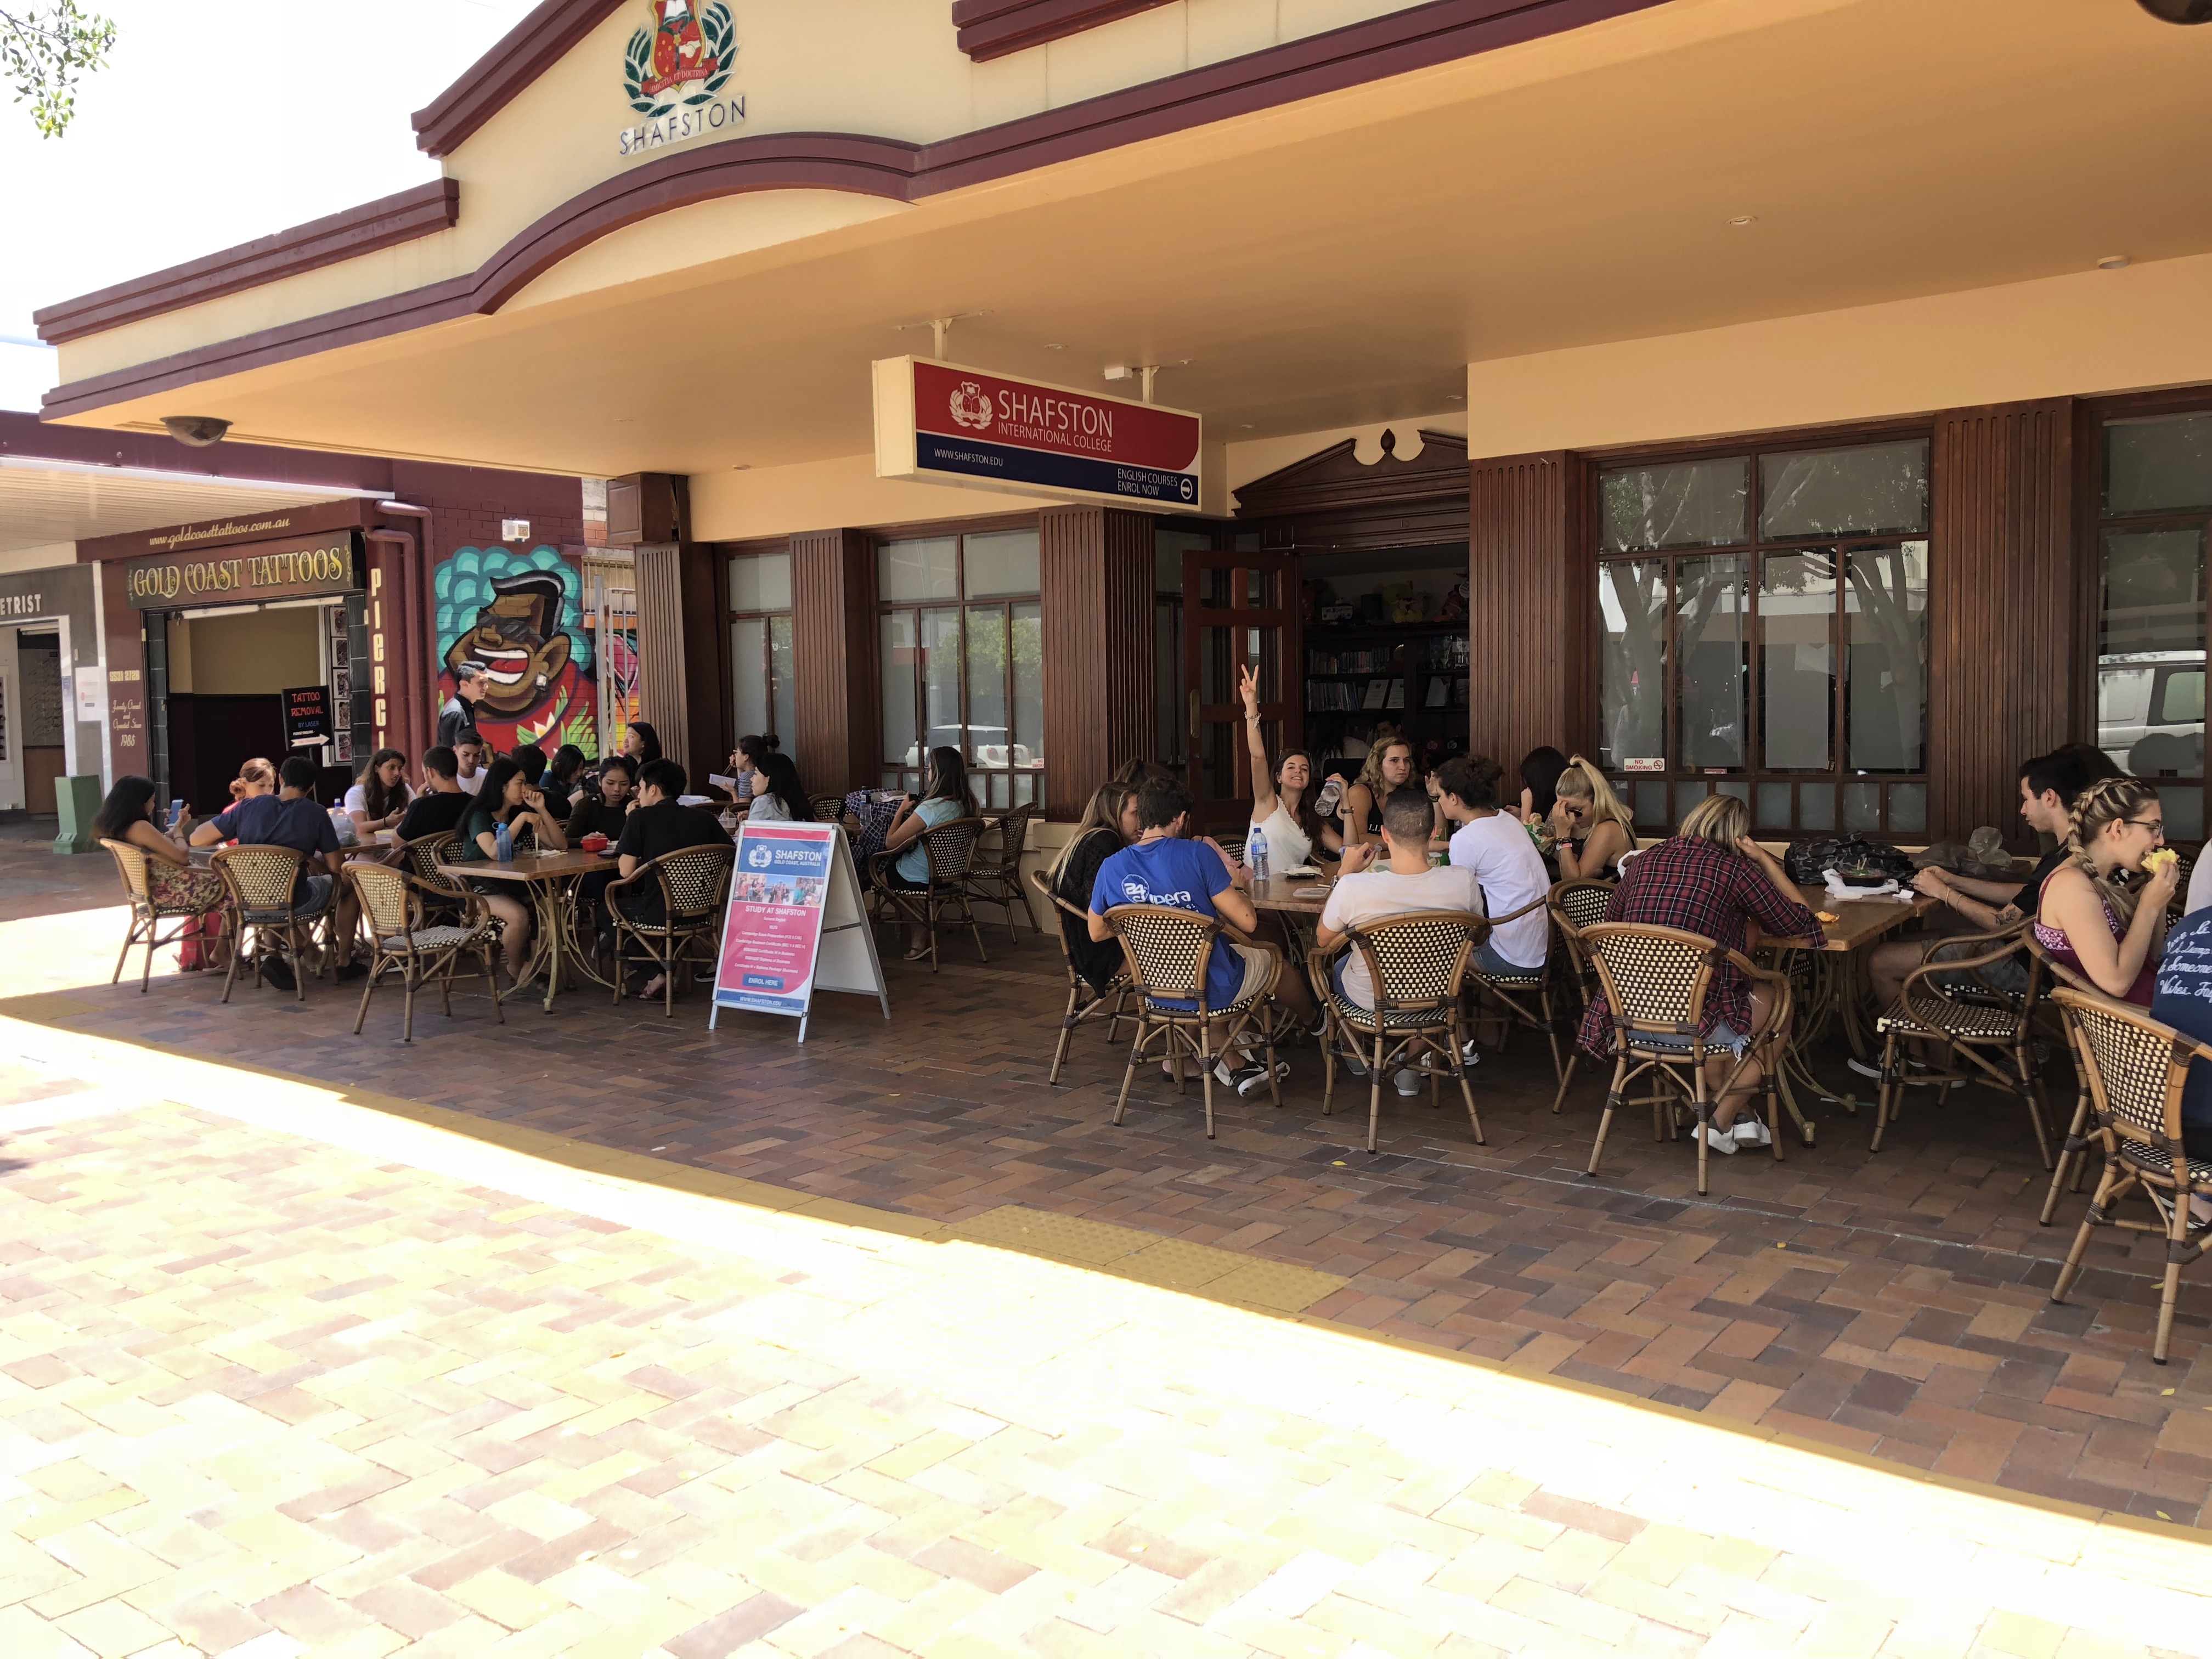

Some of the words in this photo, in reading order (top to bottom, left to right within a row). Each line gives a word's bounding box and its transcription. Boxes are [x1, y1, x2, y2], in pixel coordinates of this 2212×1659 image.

[673, 72, 681, 81] ET
[681, 68, 708, 78] DOCTRINA
[619, 95, 746, 156] SHAFSTON
[998, 389, 1113, 438] SHAFSTON
[998, 421, 1071, 447] INTERNATIONAL
[1073, 435, 1112, 453] COLLEGE
[934, 448, 1003, 467] WWW.SHAFSTON.EDU
[1118, 468, 1147, 482] ENGLISH
[1148, 473, 1178, 487] COURSES
[1118, 480, 1141, 494] ENROL
[1142, 484, 1159, 496] NOW
[149, 517, 290, 549] www.goldcoasttattoos.com.au
[134, 565, 180, 599] GOLD
[184, 558, 242, 595] COAST
[247, 547, 343, 587] TATTOOS
[0, 594, 42, 616] ETRIST
[291, 692, 320, 703] TATTOO
[290, 706, 324, 716] REMOVAL
[775, 850, 822, 861] SHAFSTON
[746, 905, 766, 913] STUDY
[775, 907, 806, 917] SHAFSTON
[748, 977, 765, 985] ENROL
[740, 997, 782, 1006] WWW.SHAFSTON.EDU
